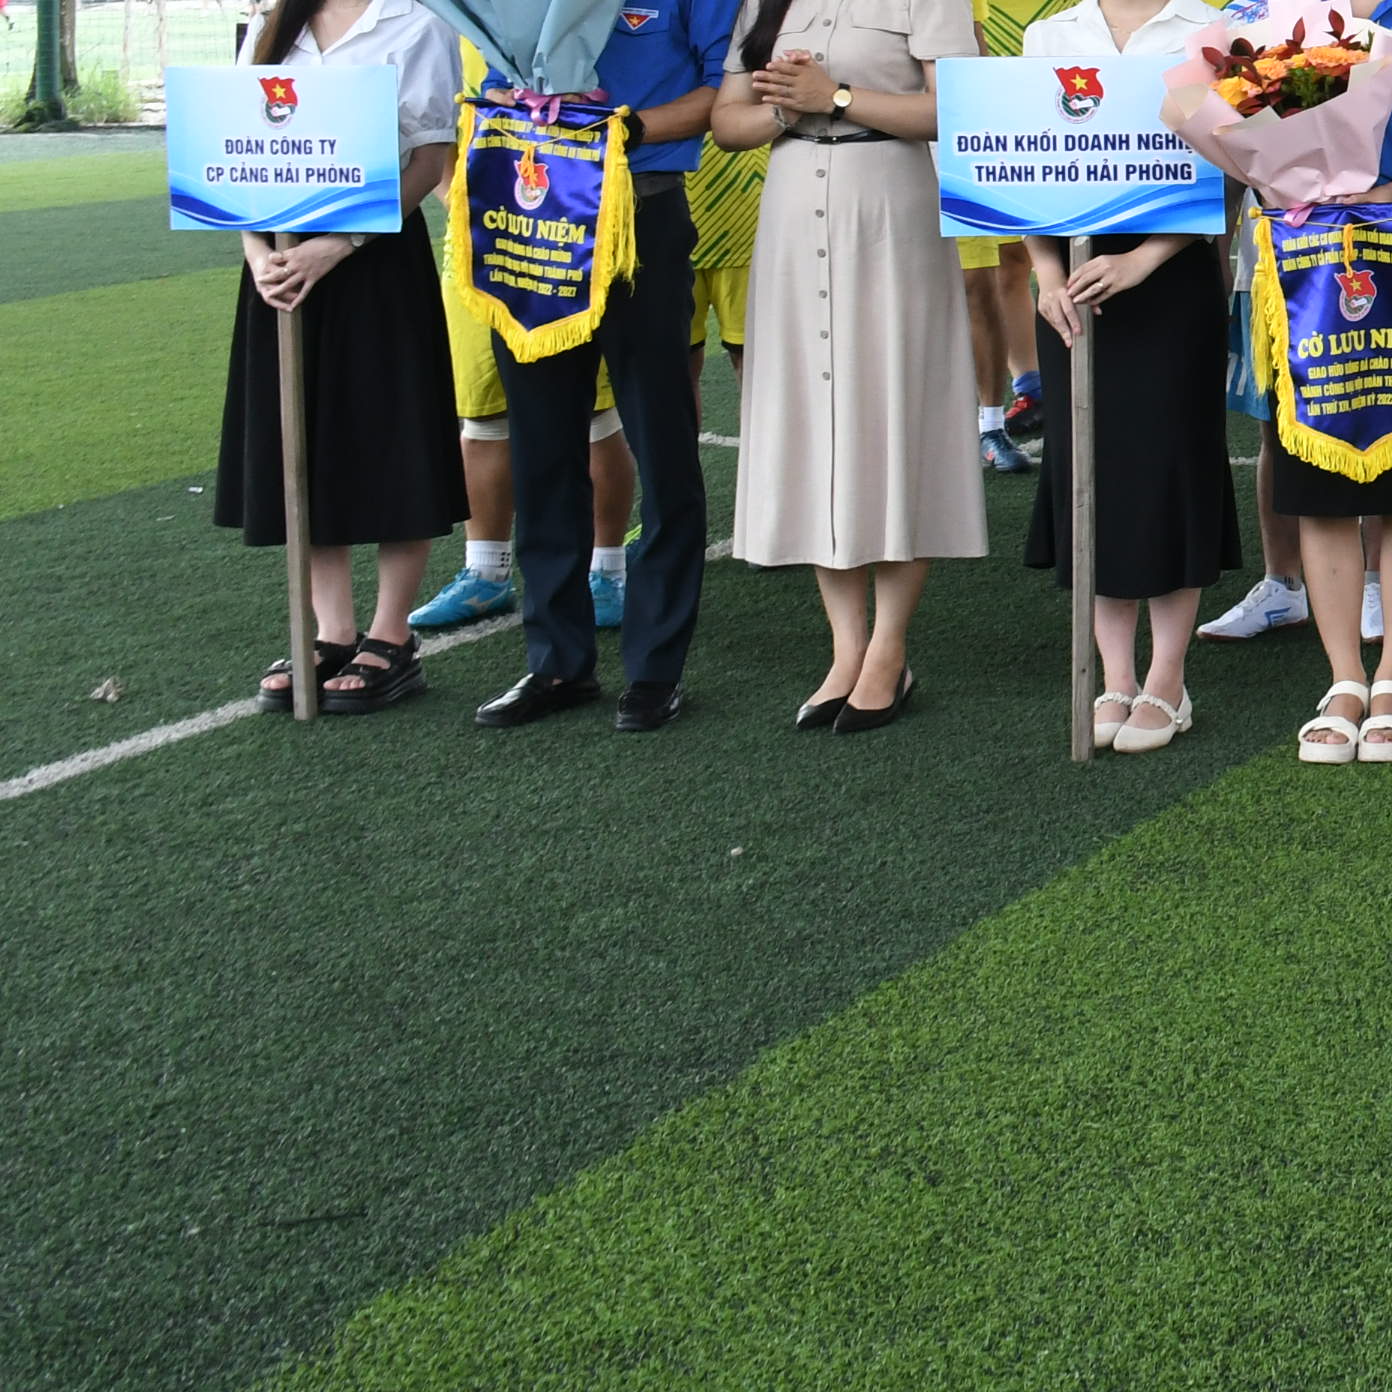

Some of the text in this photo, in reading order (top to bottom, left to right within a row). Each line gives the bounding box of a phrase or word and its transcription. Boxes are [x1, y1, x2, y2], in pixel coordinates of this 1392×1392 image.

[225, 135, 337, 155] ĐOÀN CÔNG TY
[957, 131, 1007, 152] ĐOÀN
[1014, 128, 1057, 152] KHỐI
[1064, 133, 1130, 152] DOANH
[206, 161, 361, 183] CP CẢNG HẢI PHÒNG
[975, 158, 1193, 182] THÀNH PHỐ HẢI PHÒNG
[536, 217, 586, 246] NIỆM
[1298, 330, 1323, 359] CỜ
[1328, 330, 1365, 355] LƯU
